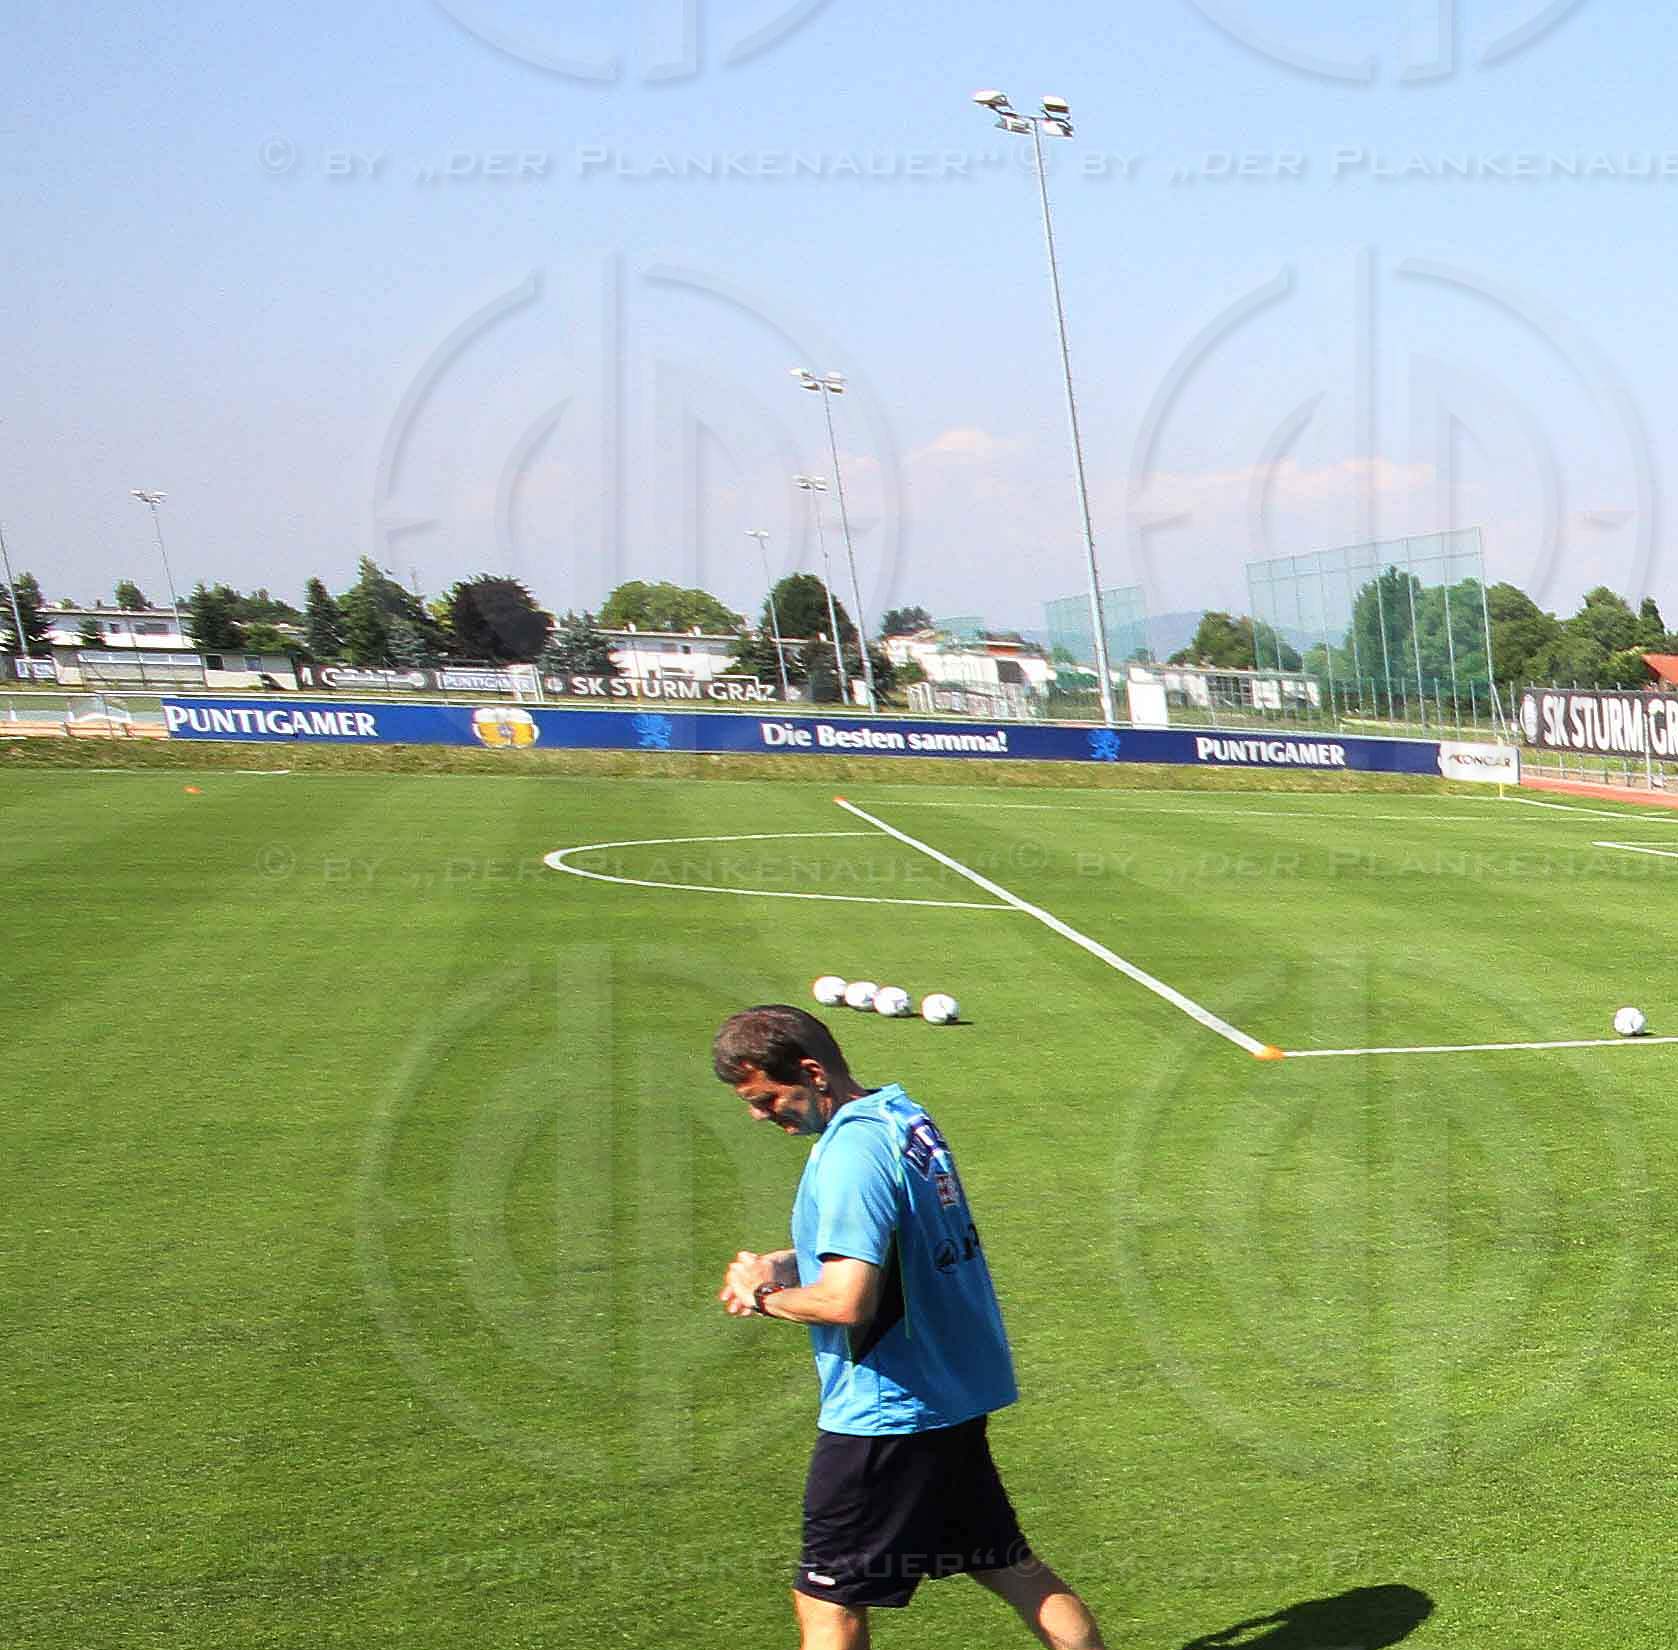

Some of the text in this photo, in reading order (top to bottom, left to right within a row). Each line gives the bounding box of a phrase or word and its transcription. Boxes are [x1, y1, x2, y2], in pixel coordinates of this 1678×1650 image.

[571, 676, 776, 702] SK STURM GRAZ
[164, 705, 379, 737] PUNTIGAMER
[1543, 695, 1571, 746] SK
[1571, 697, 1645, 753] STURM
[760, 722, 1008, 752] Die Besten samma!
[1195, 737, 1346, 767] PUNTIGAMER
